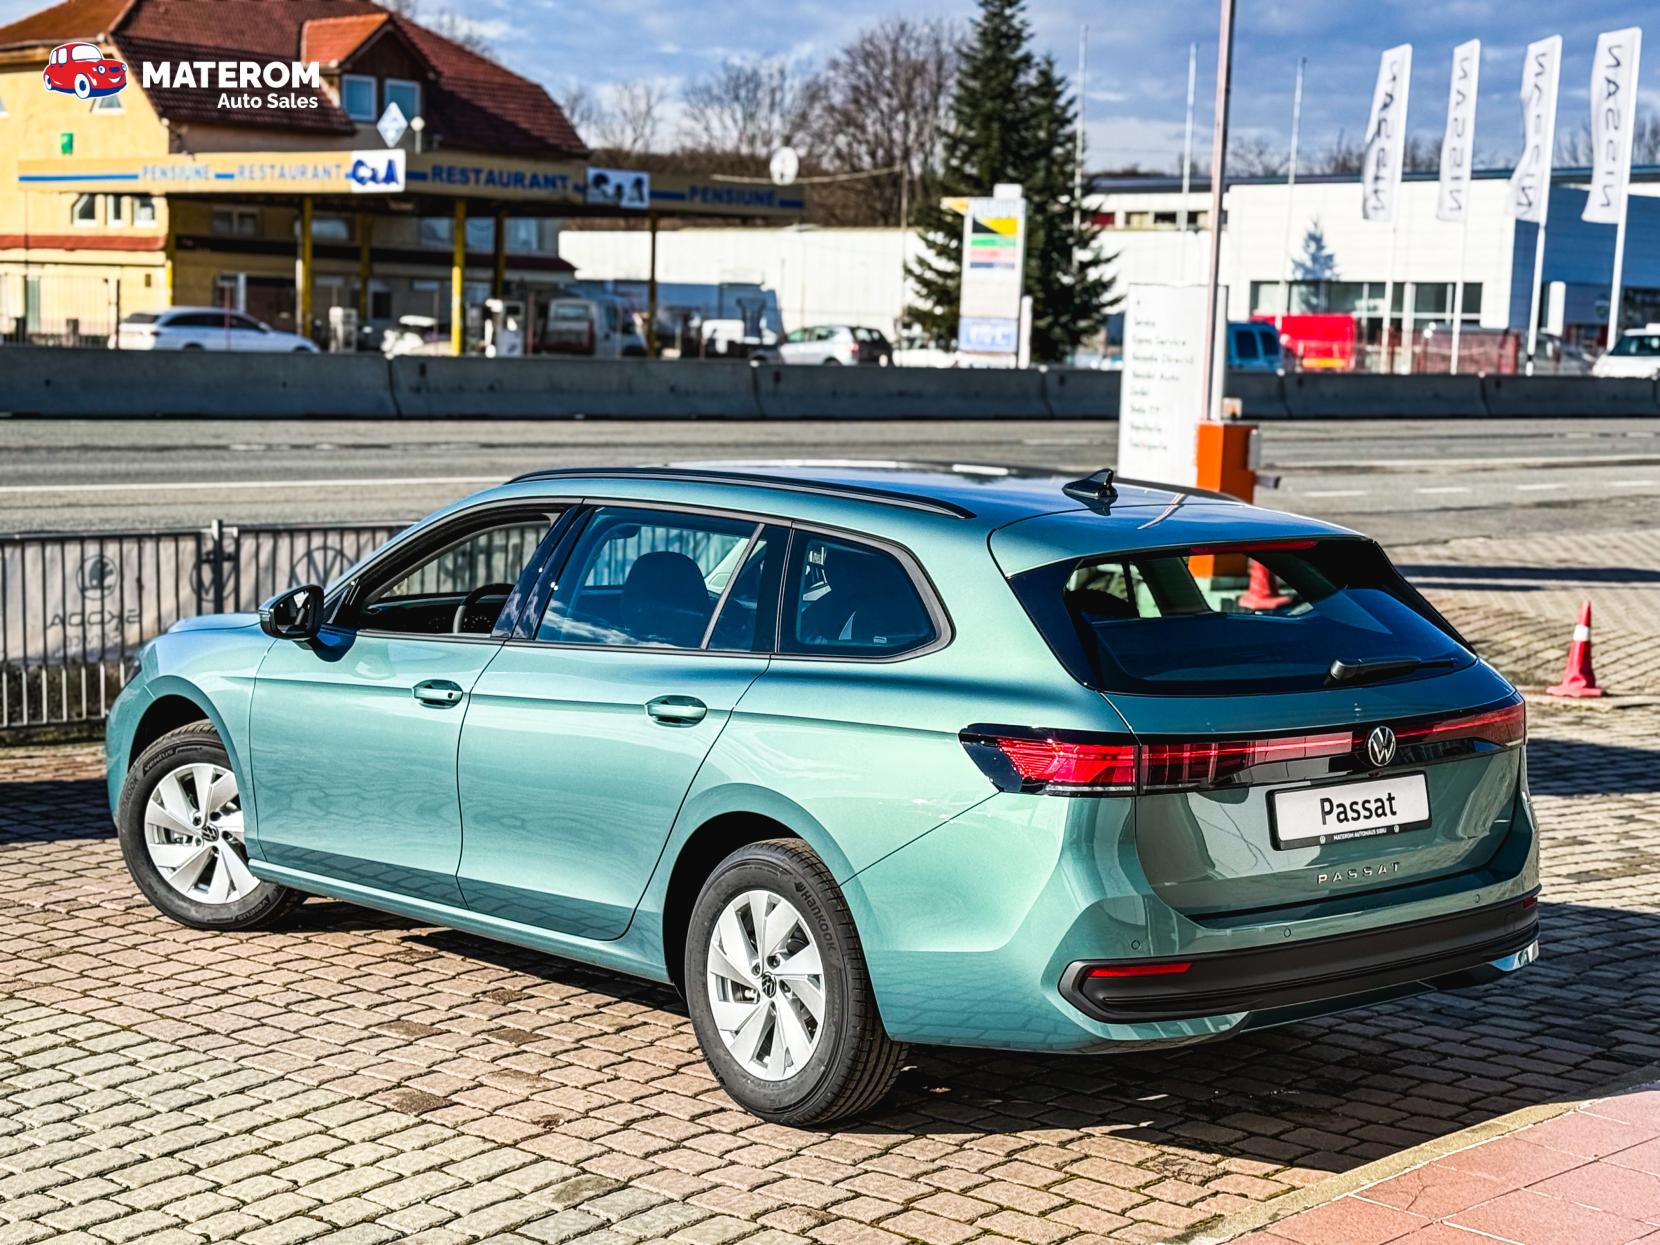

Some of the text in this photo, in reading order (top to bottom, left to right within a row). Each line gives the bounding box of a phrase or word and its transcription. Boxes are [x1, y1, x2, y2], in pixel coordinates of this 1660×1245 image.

[237, 163, 342, 181] RESTAURANT
[430, 163, 569, 192] RESTAURANT
[689, 185, 775, 207] PENSIUNE
[1319, 792, 1397, 826] Passat
[1316, 861, 1401, 885] PASSAT
